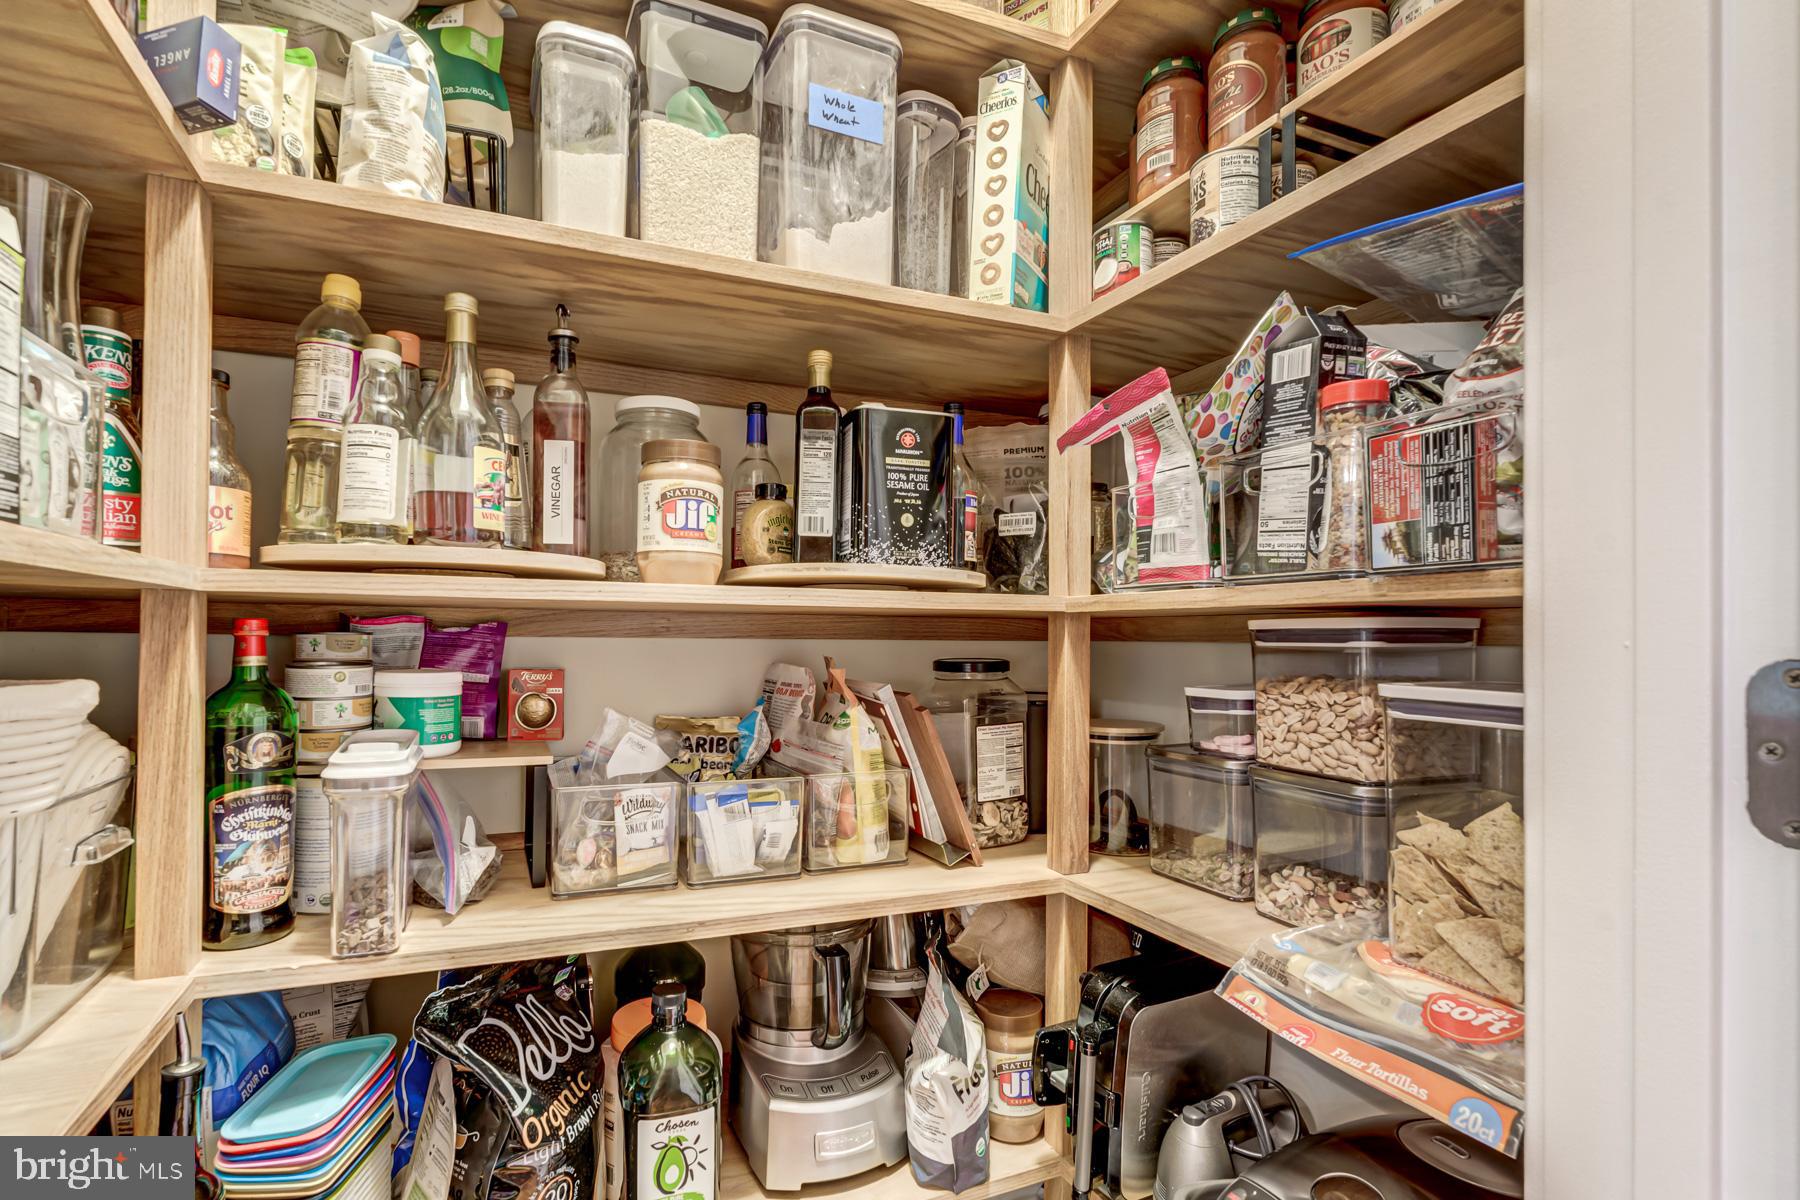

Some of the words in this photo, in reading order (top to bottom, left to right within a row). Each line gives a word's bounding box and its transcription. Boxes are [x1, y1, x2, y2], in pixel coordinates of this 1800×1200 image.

[154, 47, 191, 67] ANGEL
[1302, 48, 1350, 85] RAO'S
[824, 95, 857, 113] Whole
[980, 96, 1018, 115] Cheerios
[821, 110, 860, 127] Wheat
[86, 343, 132, 370] KEN'S
[1121, 410, 1151, 428] Nutrition
[1003, 446, 1045, 456] PREMIUM
[102, 454, 133, 473] EN'S
[886, 480, 915, 490] SESAME
[917, 482, 930, 491] OIL
[888, 472, 907, 481] 100%
[909, 473, 929, 483] PURE
[551, 465, 561, 519] VINEGAR
[665, 488, 715, 501] NATURAL
[103, 498, 133, 515] sty
[210, 505, 233, 521] ot
[665, 499, 716, 530] Jif
[103, 509, 137, 525] lian
[1258, 542, 1275, 550] Facts
[625, 822, 648, 835] SNACK
[651, 819, 664, 831] MIX
[299, 1009, 321, 1019] Crust
[1431, 999, 1511, 1034] soft
[457, 993, 596, 1117] Della
[241, 1073, 261, 1101] FLOUR
[258, 1063, 270, 1080] IQ
[780, 1084, 794, 1094] On
[820, 1083, 835, 1095] Off
[860, 1067, 880, 1083] Pulse
[1330, 1047, 1366, 1071] Flour
[1365, 1060, 1429, 1101] Tortillas
[1002, 1072, 1033, 1098] Ji
[118, 1108, 133, 1119] Nu
[522, 1071, 591, 1149] Organic
[655, 1119, 699, 1134] Chosen
[1454, 1105, 1497, 1143] 20ct
[522, 1138, 566, 1165] Light
[565, 1106, 596, 1143] Brown
